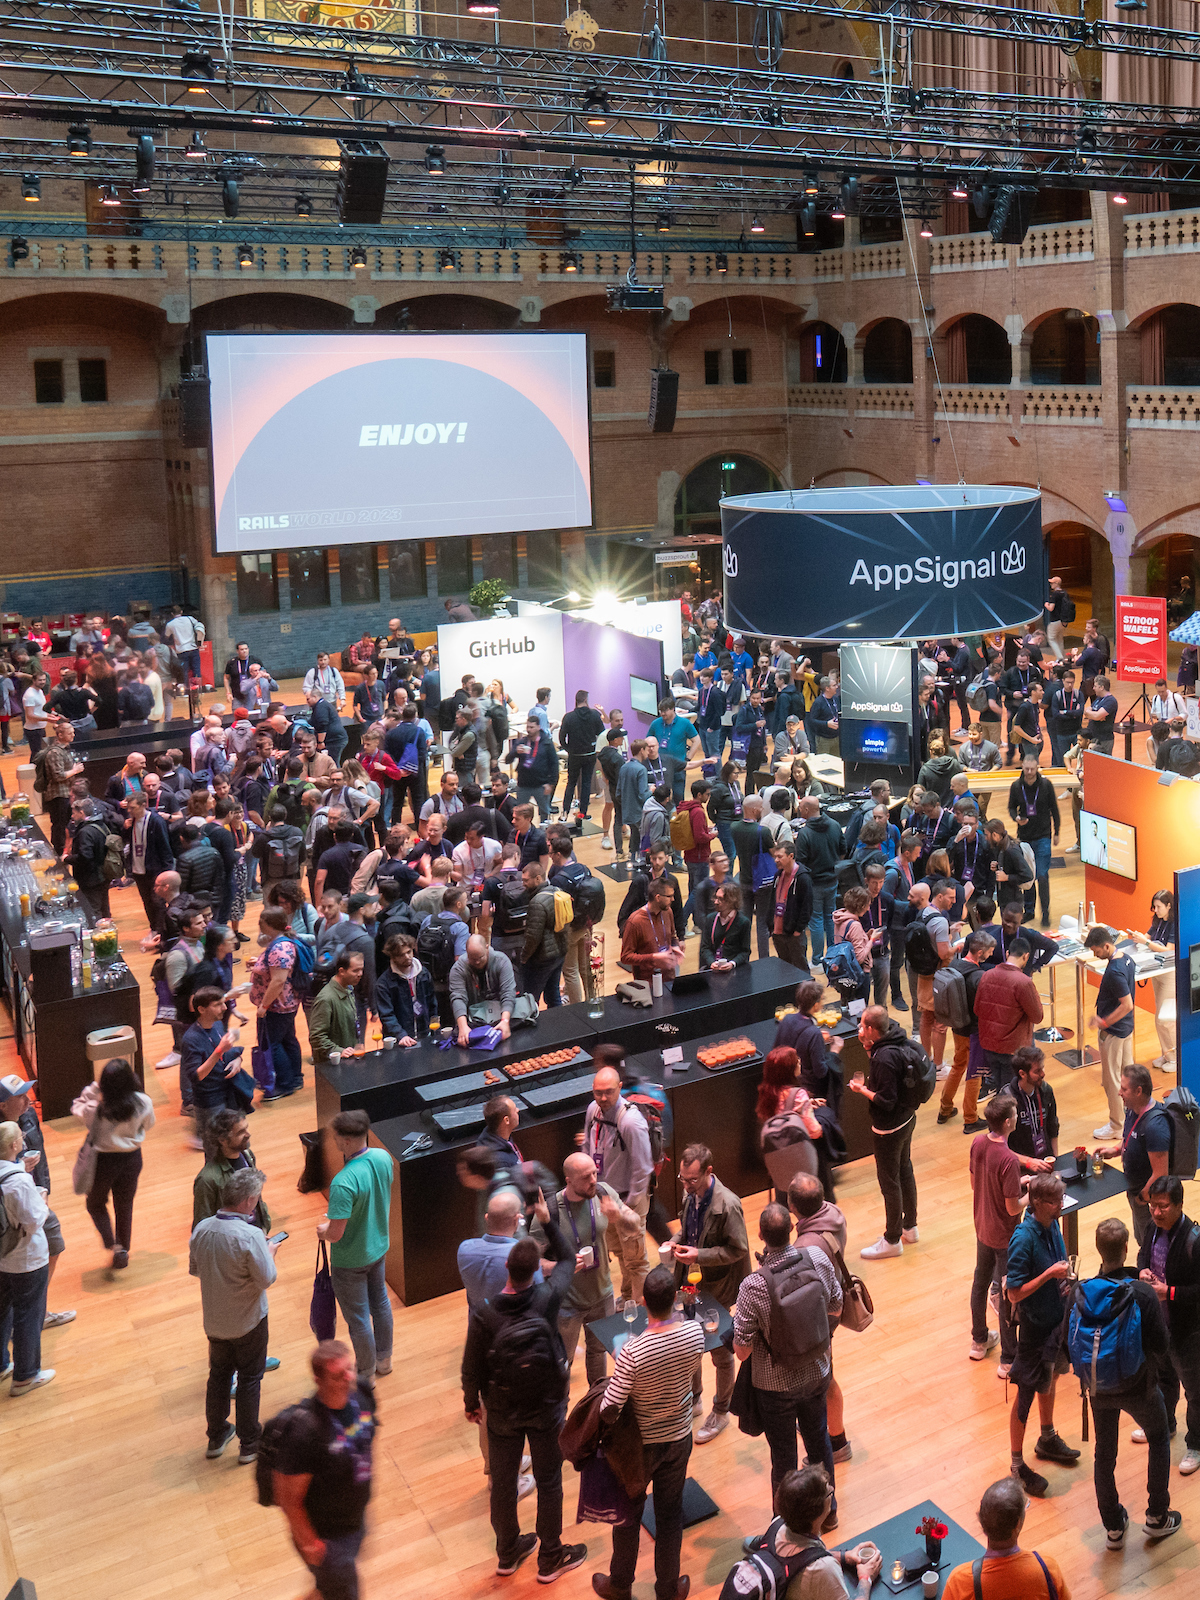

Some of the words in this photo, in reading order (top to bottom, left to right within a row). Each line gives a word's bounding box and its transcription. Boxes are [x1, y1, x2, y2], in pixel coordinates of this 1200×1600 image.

[359, 422, 468, 446] ENJOY!
[239, 515, 290, 531] RAILS
[358, 508, 402, 523] 2023
[656, 553, 690, 561] buzzsprout
[849, 551, 996, 591] AppSignal
[1123, 615, 1160, 626] STROOP
[1123, 624, 1159, 635] WAFELS
[469, 636, 536, 658] GitHub
[1123, 664, 1151, 674] AppSignal
[851, 701, 890, 713] AppSignal
[864, 738, 885, 746] simple
